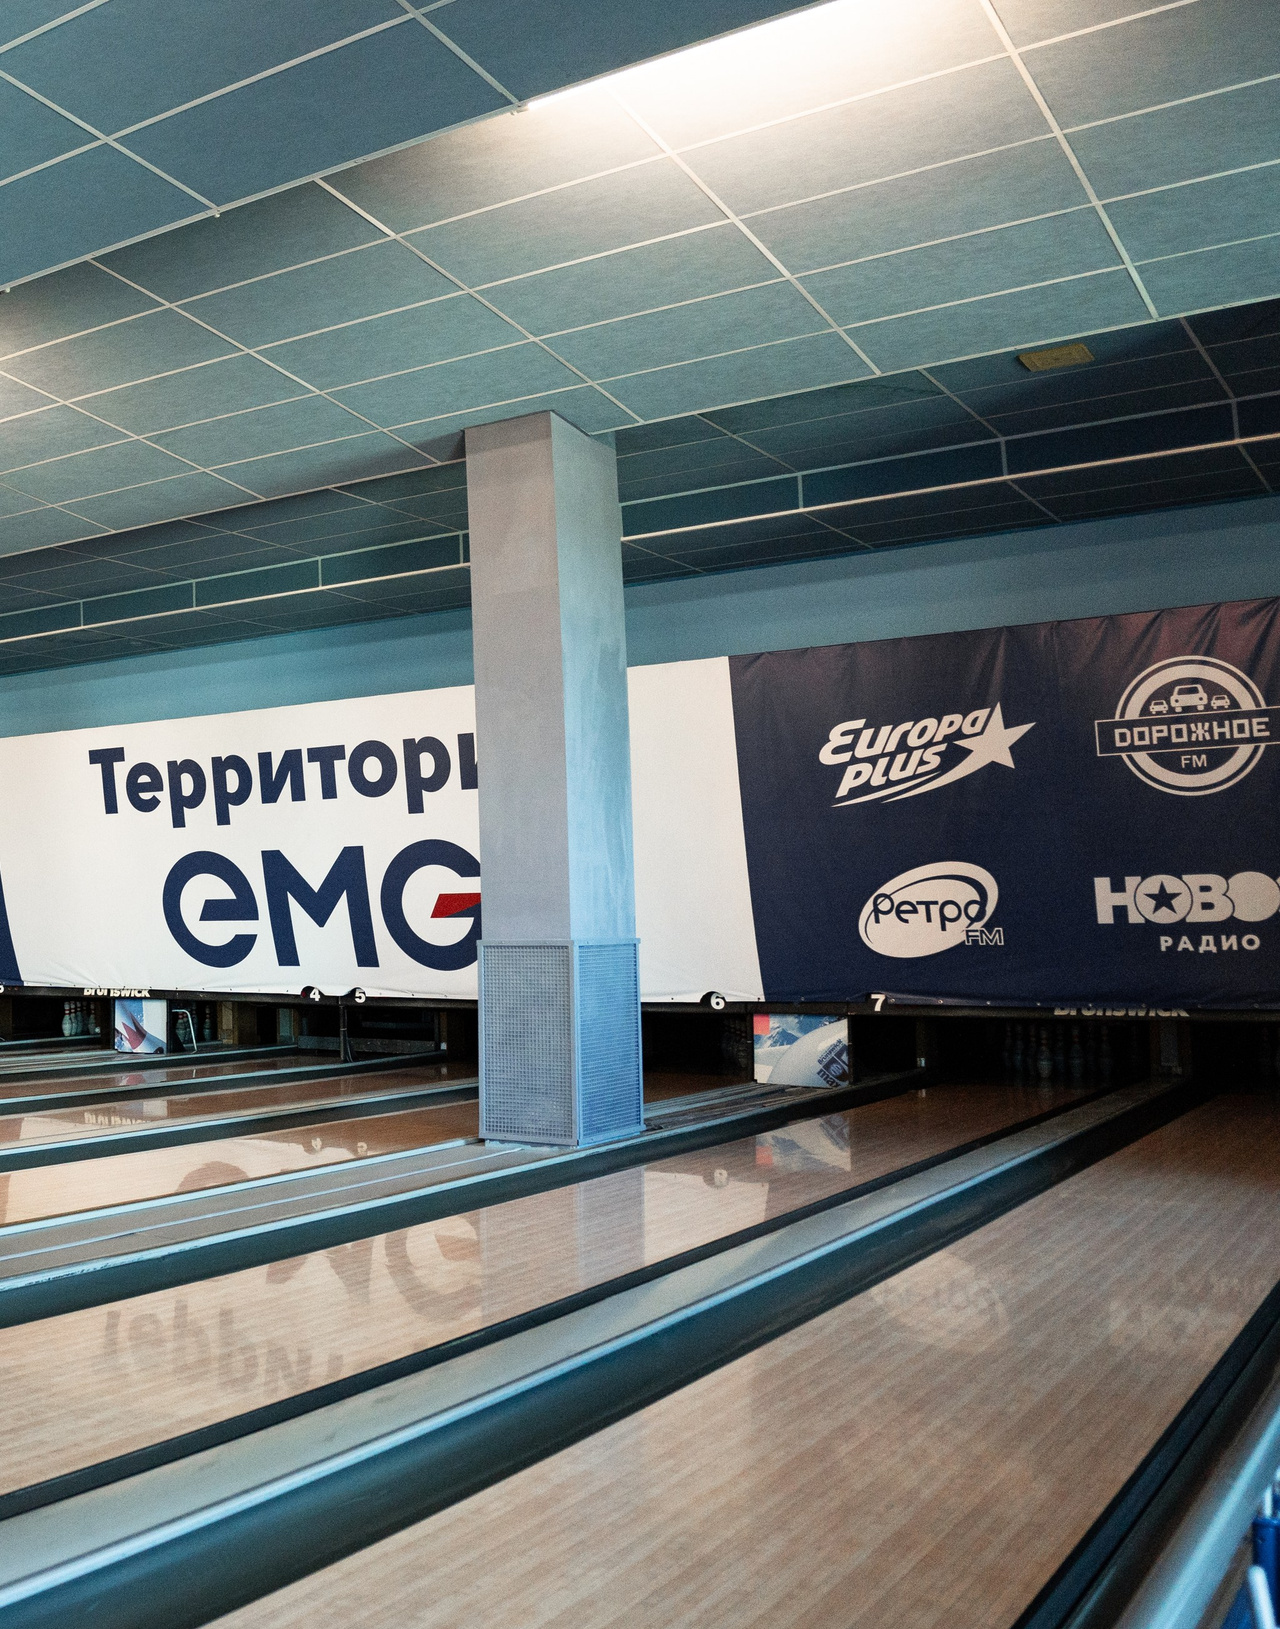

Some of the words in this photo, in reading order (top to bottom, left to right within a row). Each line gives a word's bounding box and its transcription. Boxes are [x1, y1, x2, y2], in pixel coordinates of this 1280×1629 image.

[1181, 754, 1208, 769] FM
[1094, 870, 1280, 925] НОВО
[872, 892, 987, 932] Ретро
[964, 927, 1005, 946] FM
[1159, 934, 1261, 954] РАДИО
[309, 987, 321, 1002] 4
[354, 988, 366, 1004] 5
[710, 992, 726, 1010] 6
[870, 993, 886, 1012] 7
